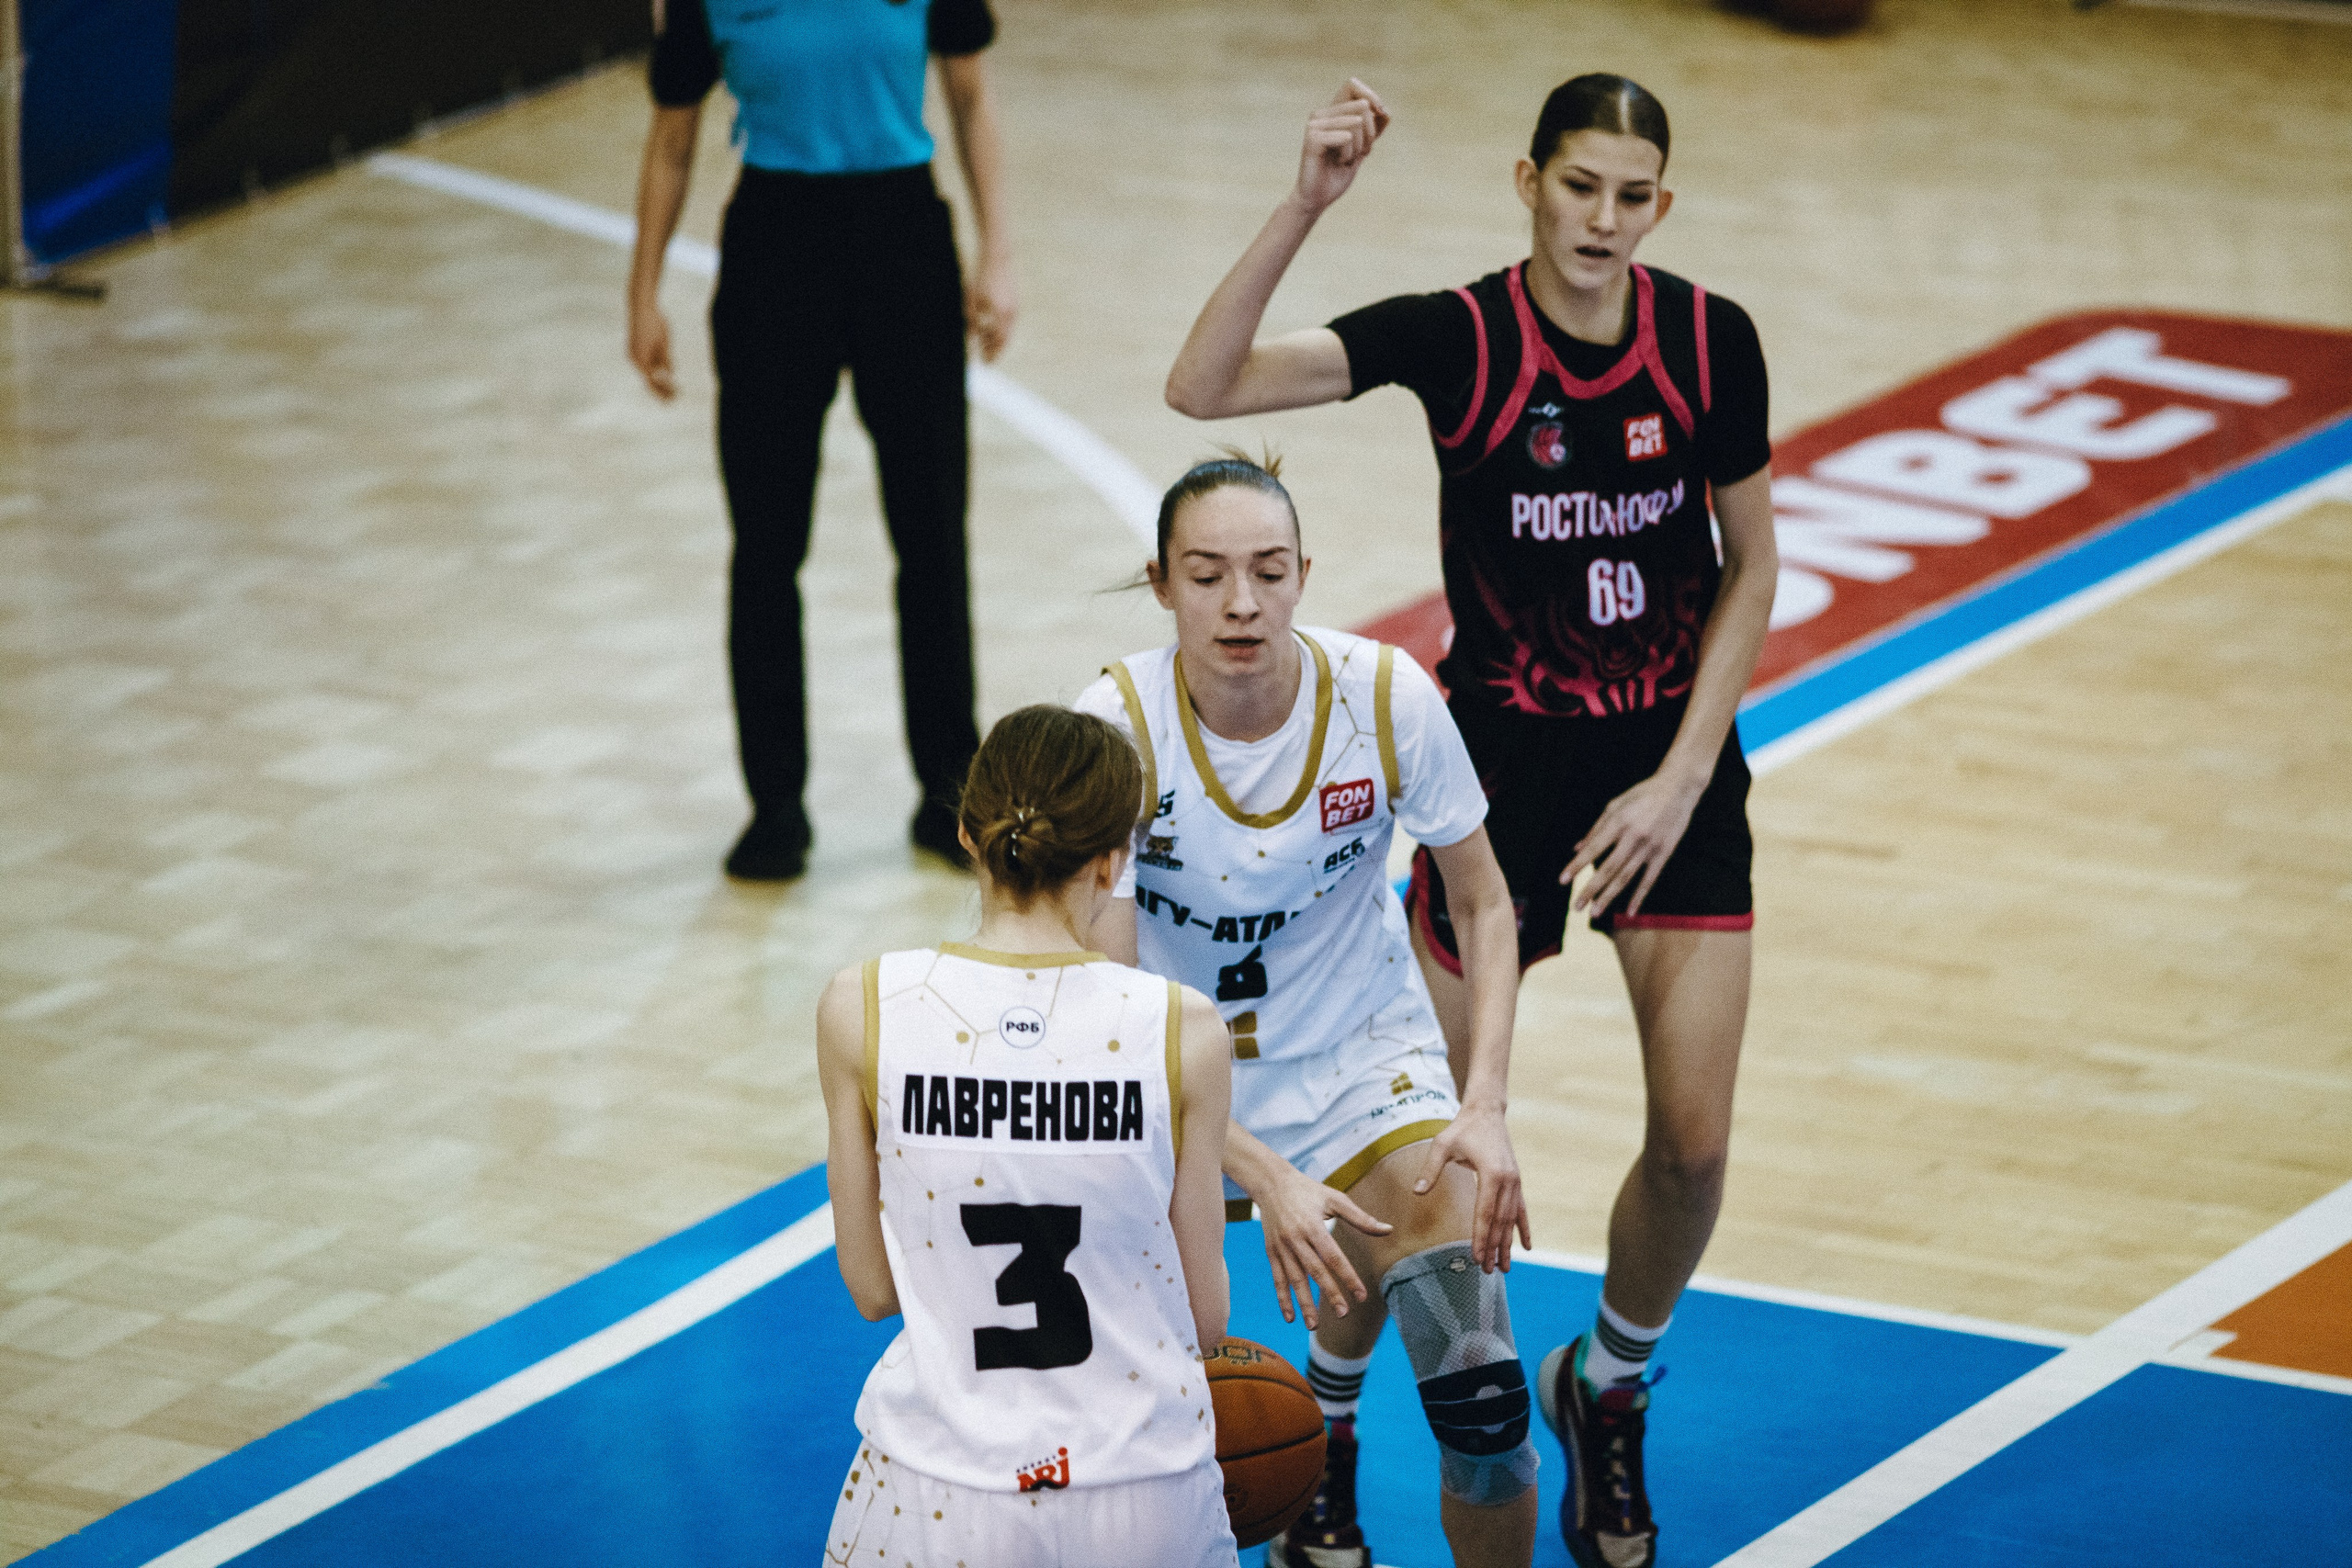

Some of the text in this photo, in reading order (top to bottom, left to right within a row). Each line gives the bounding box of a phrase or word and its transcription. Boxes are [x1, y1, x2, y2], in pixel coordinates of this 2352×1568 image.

[1587, 558, 1646, 626] 69
[1325, 784, 1371, 810] FON
[1326, 801, 1371, 828] BET
[1006, 1021, 1040, 1033] РФБ
[902, 1074, 1144, 1142] ЛАВРЕНОВА
[959, 1203, 1093, 1371] 3
